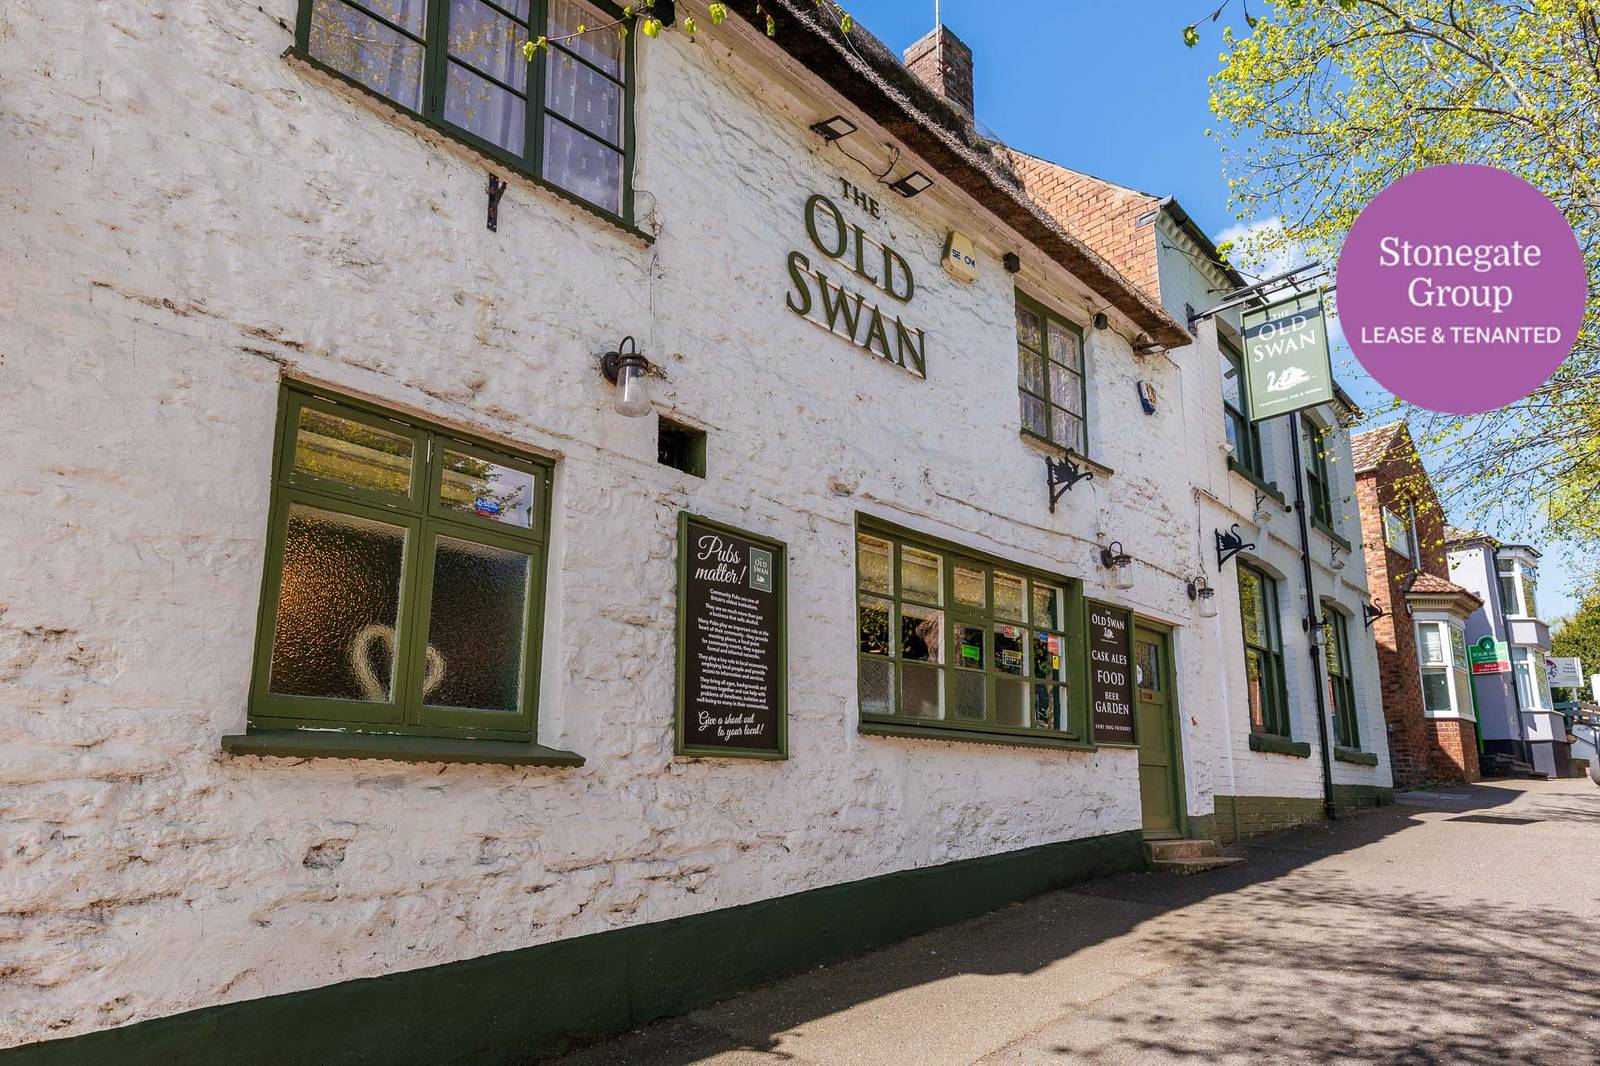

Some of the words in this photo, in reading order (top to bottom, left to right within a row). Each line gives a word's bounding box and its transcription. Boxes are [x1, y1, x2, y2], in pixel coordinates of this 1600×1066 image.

[839, 177, 881, 220] THE
[805, 194, 914, 303] OLD
[787, 251, 926, 379] SWAN
[1270, 309, 1290, 321] THE
[1258, 315, 1307, 340] OLD
[1253, 329, 1316, 362] SWAN
[697, 536, 740, 564] Pubs
[754, 558, 768, 568] OLD
[754, 566, 769, 575] SWAN
[694, 563, 747, 585] matter!
[1091, 613, 1107, 626] OLD
[1107, 617, 1125, 631] SWAN
[1091, 650, 1110, 662] CASK
[1111, 654, 1128, 666] ALES
[1097, 670, 1125, 686] FOOD
[1104, 692, 1120, 700] BEER
[1095, 700, 1129, 716] GARDEN
[698, 711, 716, 732] Give
[724, 713, 743, 724] shout
[744, 713, 755, 724] out
[718, 726, 725, 737] to
[726, 727, 742, 741] your
[744, 724, 764, 736] local!
